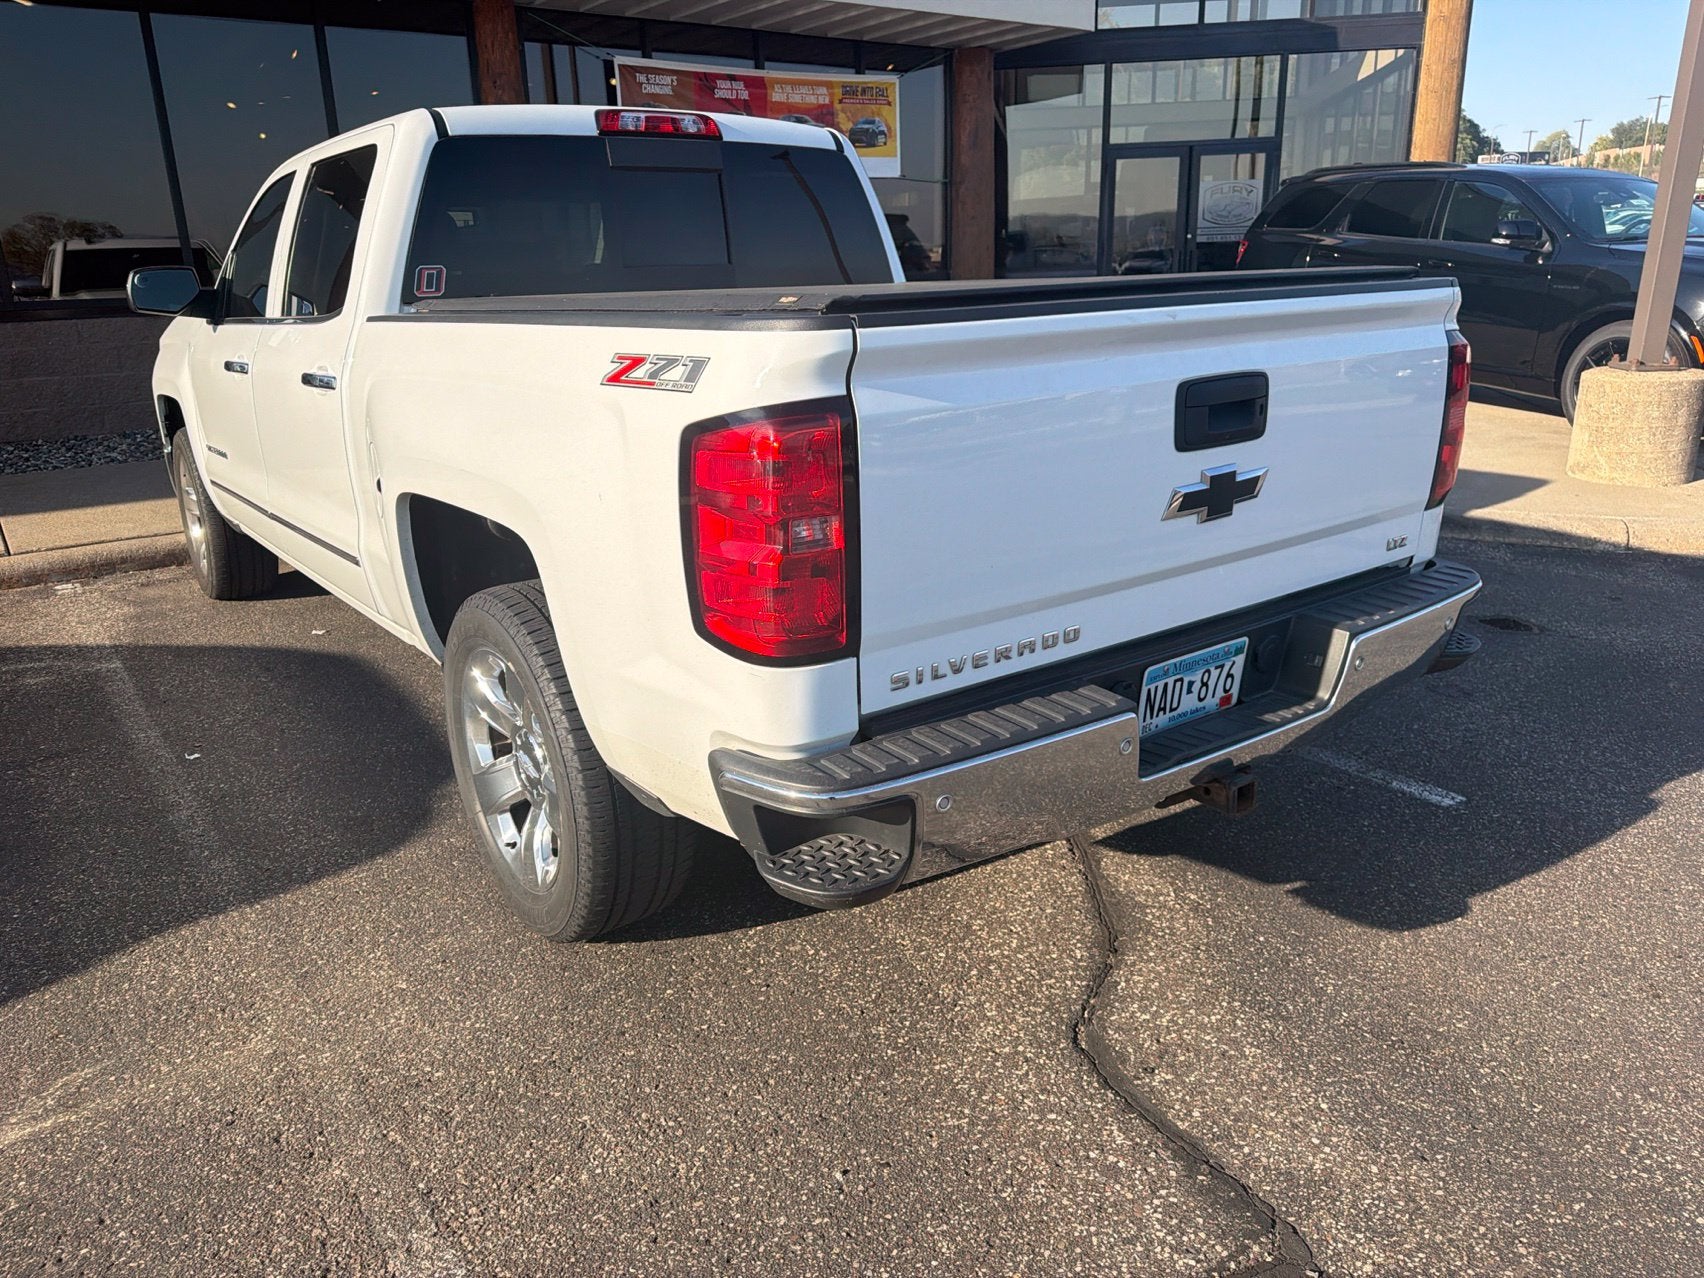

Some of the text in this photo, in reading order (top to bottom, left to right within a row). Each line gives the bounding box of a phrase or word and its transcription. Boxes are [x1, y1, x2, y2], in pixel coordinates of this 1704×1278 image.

[635, 73, 678, 86] THE SEASON'S
[716, 80, 731, 89] YOUR
[714, 89, 737, 99] SHOULD
[841, 85, 860, 97] DRIVE
[860, 86, 875, 98] INTO
[1210, 185, 1254, 198] FURY
[600, 352, 711, 393] Z71
[671, 382, 694, 390] ROAD
[1386, 534, 1408, 552] LTZ
[890, 624, 1081, 692] SILVERADO
[1171, 652, 1220, 674] Minnesota
[1142, 659, 1236, 723] NAD 876
[1189, 705, 1206, 715] lakes
[1141, 721, 1153, 735] DEC
